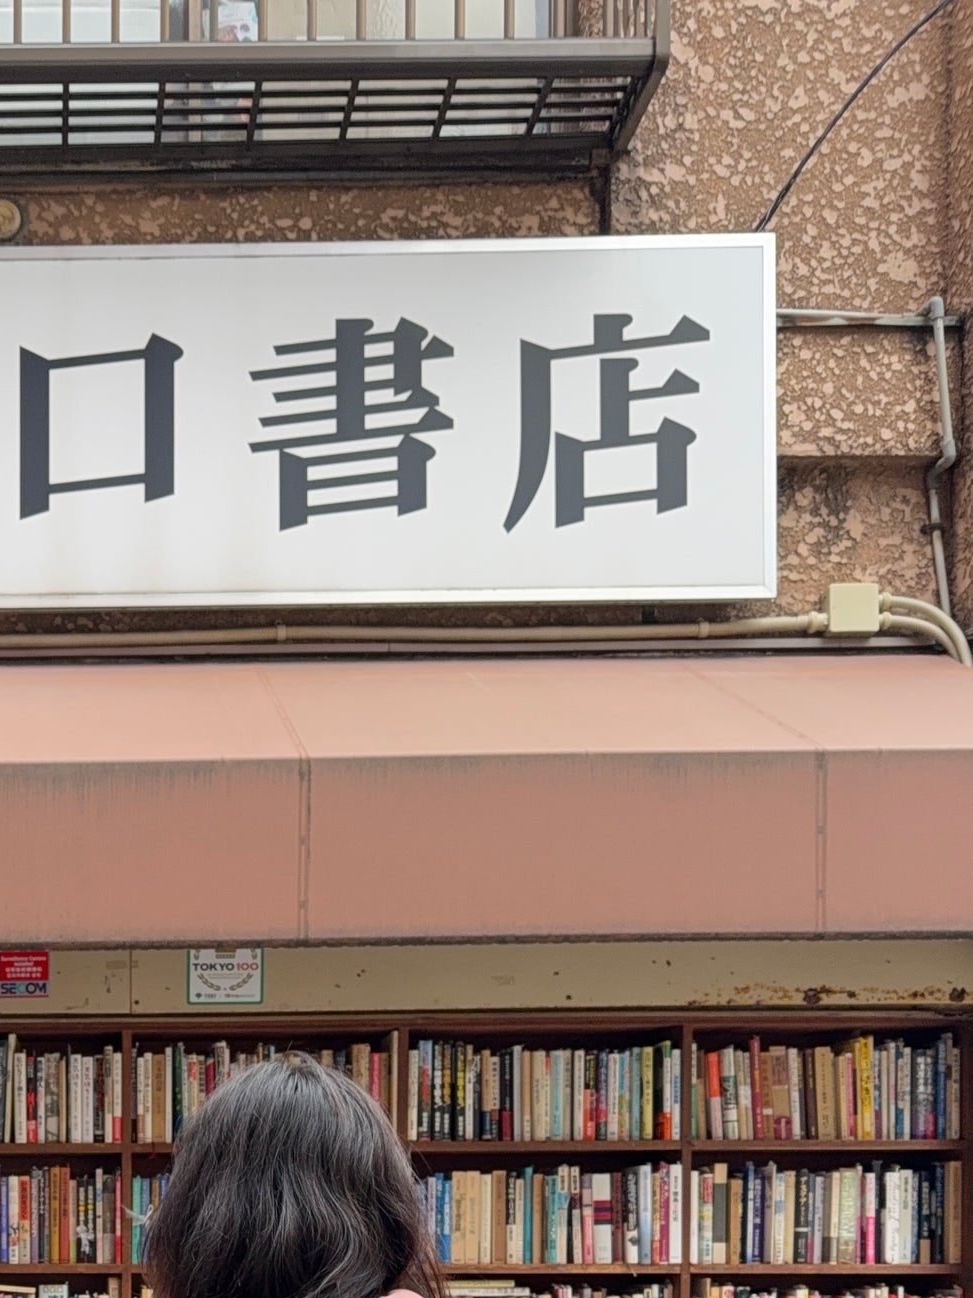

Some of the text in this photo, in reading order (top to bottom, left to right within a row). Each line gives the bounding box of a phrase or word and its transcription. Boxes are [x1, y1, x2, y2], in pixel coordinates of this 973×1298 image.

[192, 962, 259, 972] TOKYO 100
[0, 982, 47, 994] SECOM
